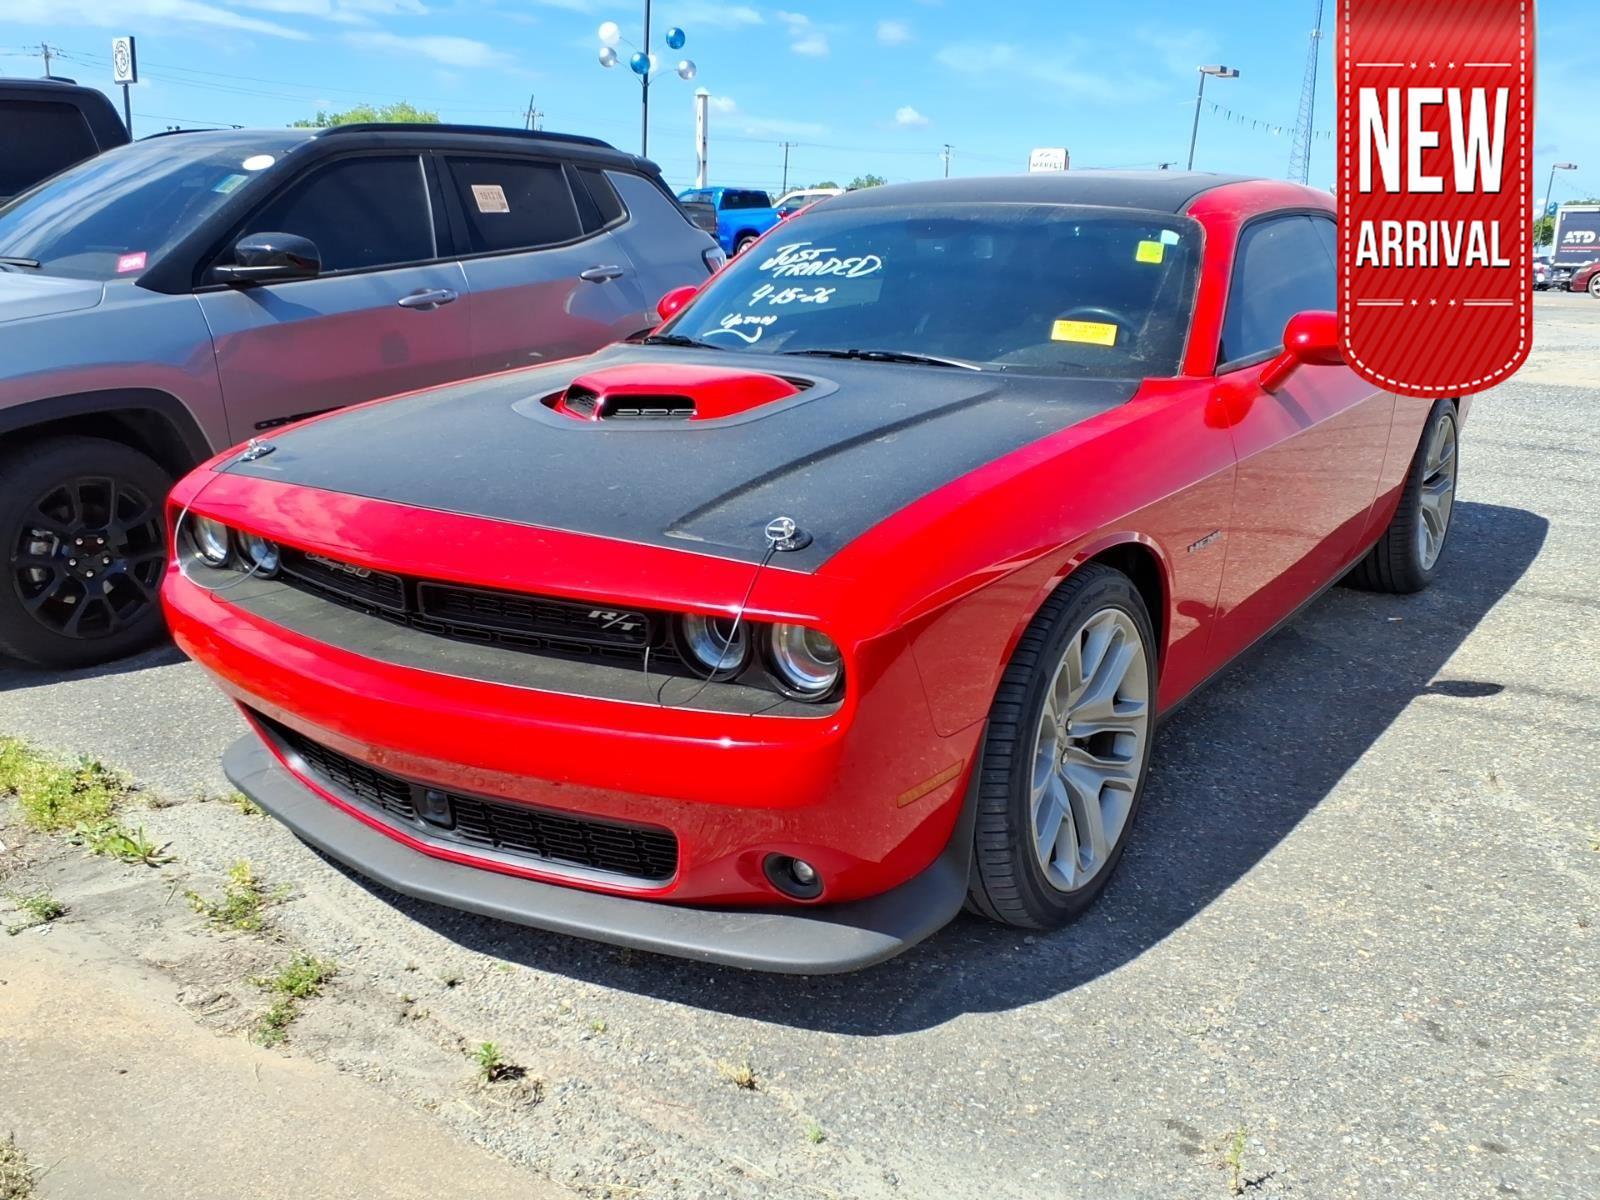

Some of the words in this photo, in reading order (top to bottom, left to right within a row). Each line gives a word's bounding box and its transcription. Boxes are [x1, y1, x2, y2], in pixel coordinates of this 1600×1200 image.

[1562, 230, 1596, 243] ATD
[772, 255, 882, 278] TRADED
[588, 610, 641, 630] R/T
